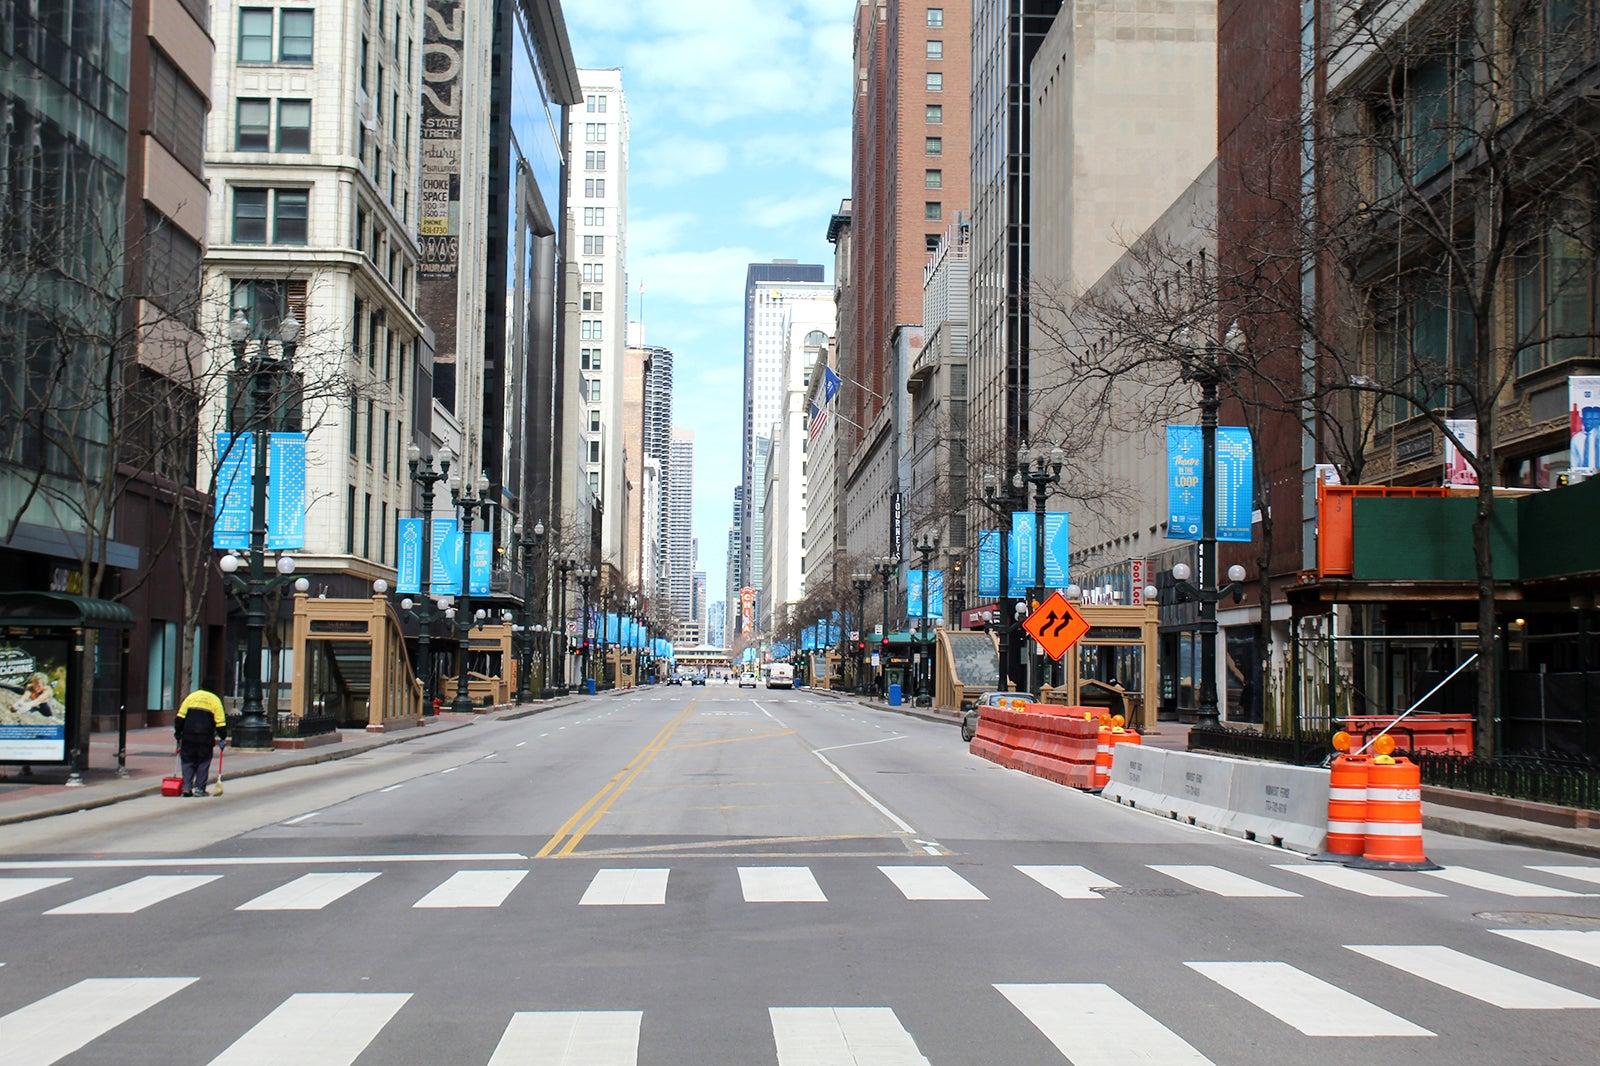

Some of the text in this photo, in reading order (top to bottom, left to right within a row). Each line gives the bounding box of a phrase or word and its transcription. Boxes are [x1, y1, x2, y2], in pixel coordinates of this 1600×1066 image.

[426, 118, 459, 129] STATE
[423, 129, 457, 138] TREET
[423, 179, 448, 190] CHOICE
[422, 191, 447, 202] SPACE
